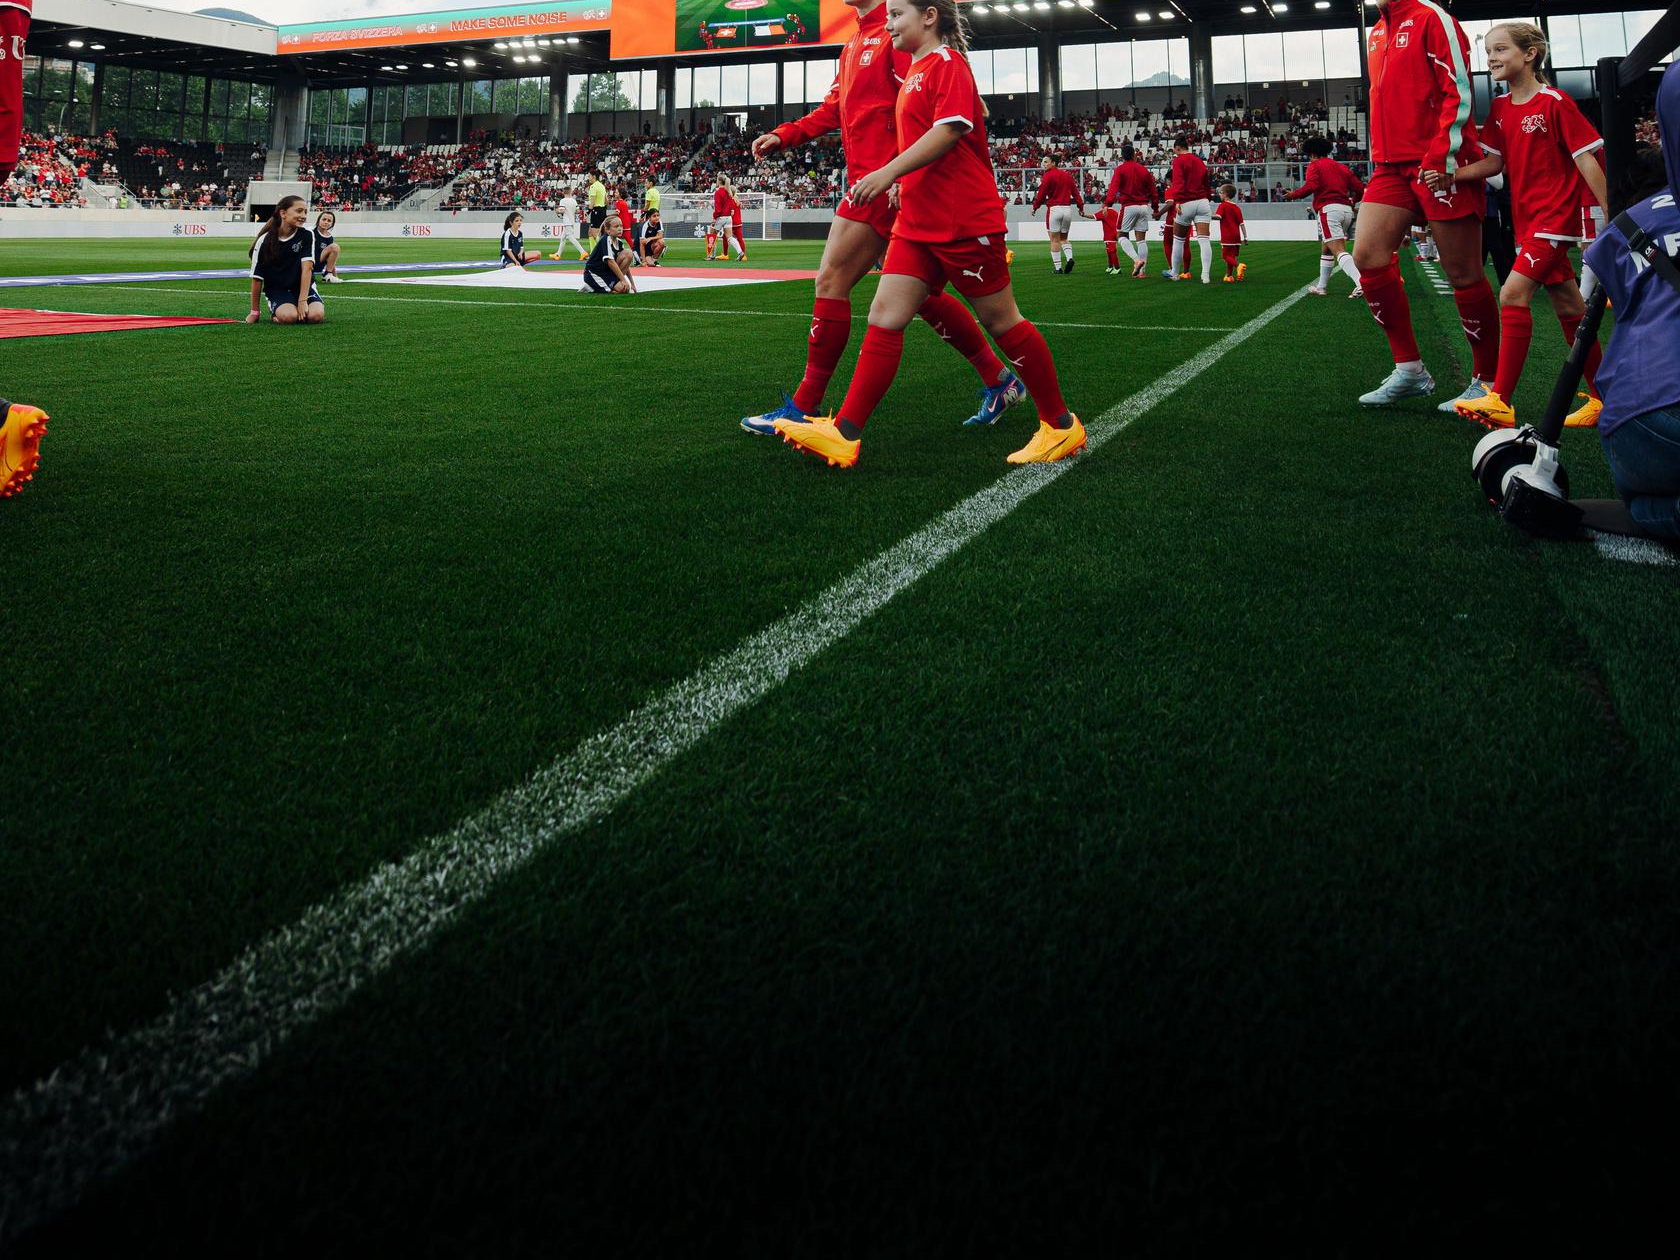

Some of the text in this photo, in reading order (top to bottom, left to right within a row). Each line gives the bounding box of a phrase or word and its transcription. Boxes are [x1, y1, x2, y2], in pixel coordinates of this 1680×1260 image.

[450, 11, 568, 32] MAKE SOME NOISE
[312, 27, 348, 43] FORZA
[184, 224, 206, 235] UBS
[412, 225, 431, 236] UBS
